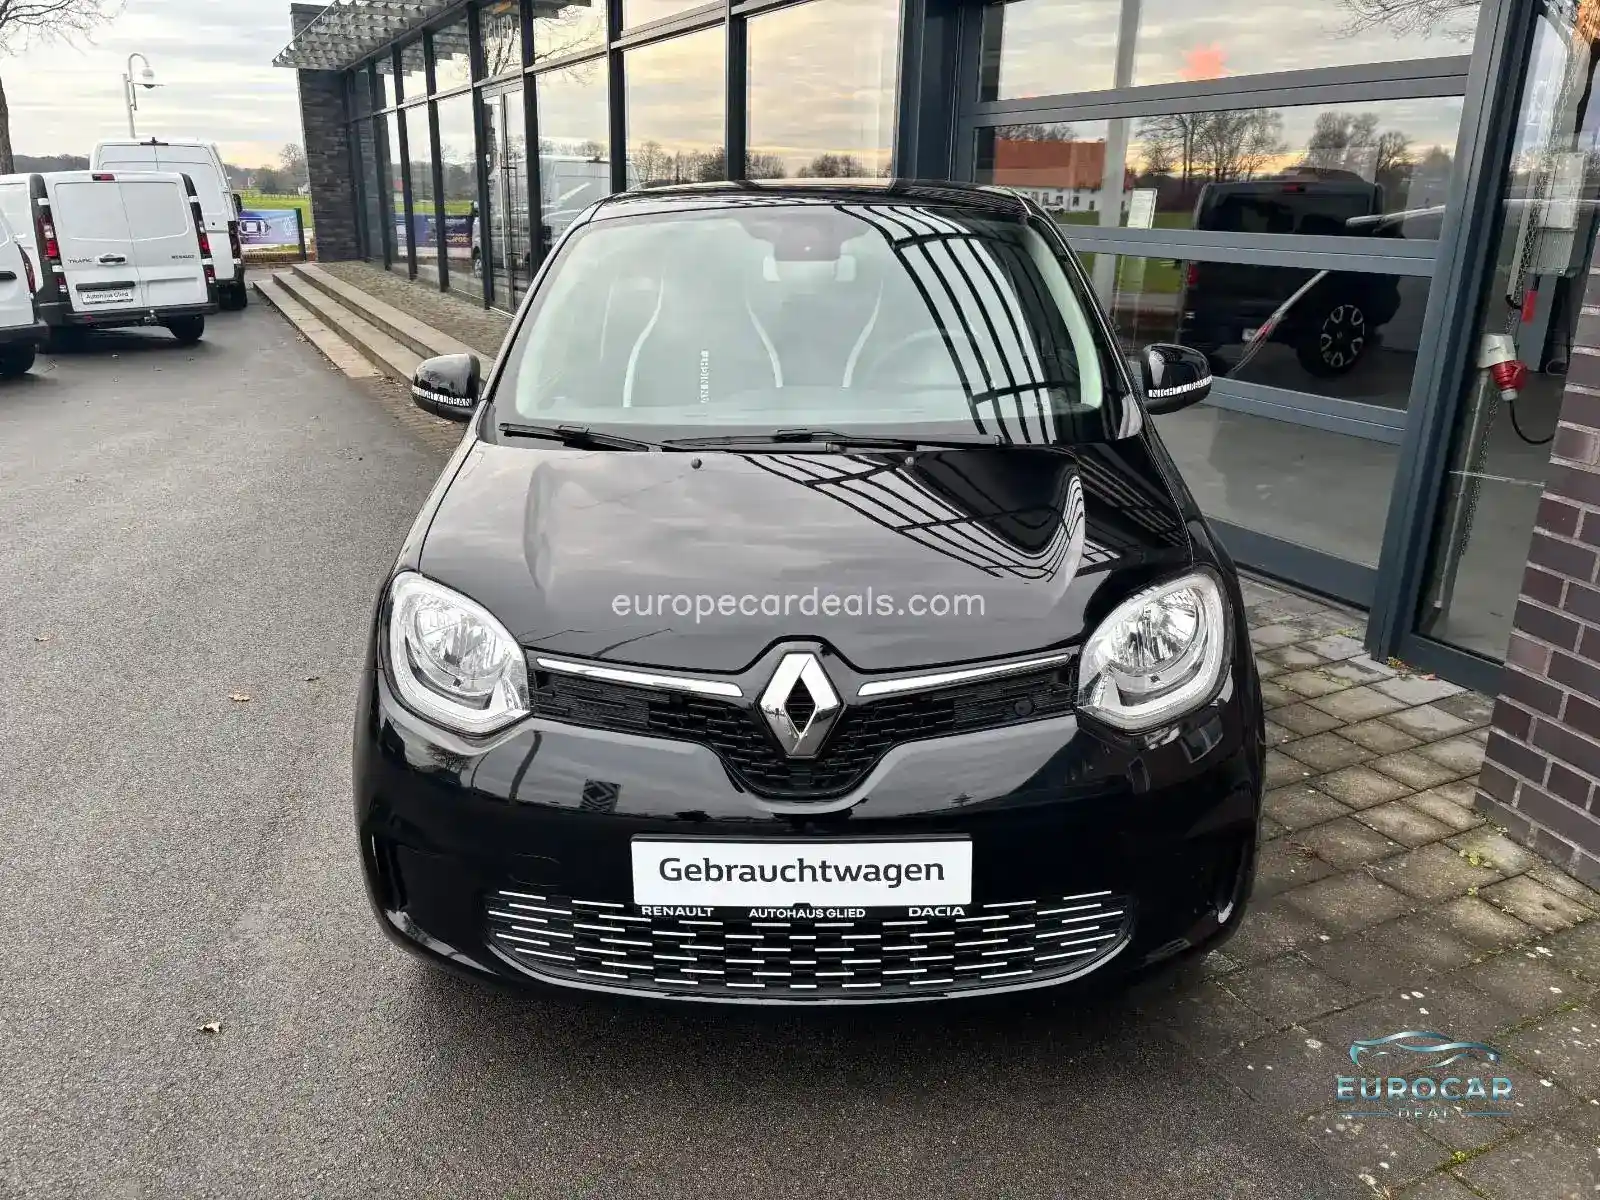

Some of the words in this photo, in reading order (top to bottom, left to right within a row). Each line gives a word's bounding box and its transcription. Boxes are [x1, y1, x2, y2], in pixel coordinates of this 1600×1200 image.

[659, 857, 944, 888] Gebrauchtwagen
[642, 905, 714, 917] RENAULT
[749, 908, 824, 919] AUTOHAUS
[826, 908, 866, 919] GLIED
[908, 906, 965, 917] DACIA
